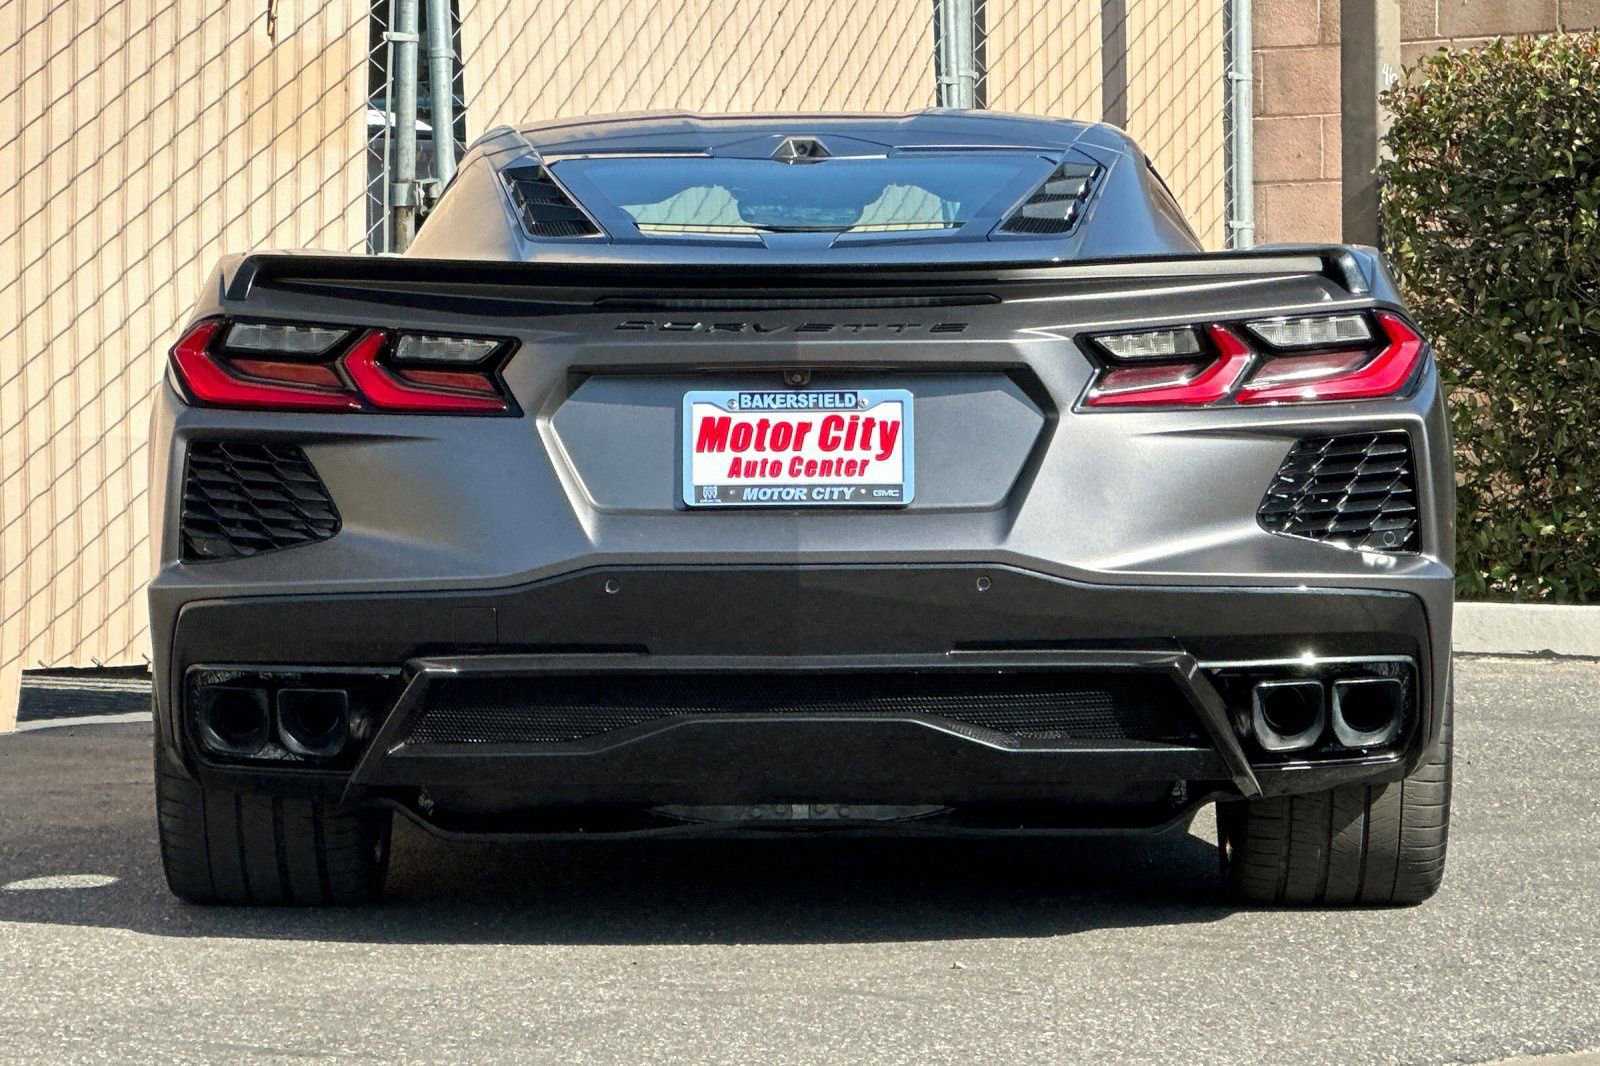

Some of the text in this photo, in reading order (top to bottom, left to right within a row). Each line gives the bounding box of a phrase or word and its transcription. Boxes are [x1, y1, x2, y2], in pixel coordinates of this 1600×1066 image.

[1382, 63, 1398, 85] 46
[614, 320, 969, 334] CORVETTE
[740, 393, 856, 408] BAKERSFIELD
[696, 414, 901, 461] Motor City
[727, 456, 870, 478] Auto Center
[742, 486, 855, 500] MOTOR CITY
[873, 489, 900, 497] GMC
